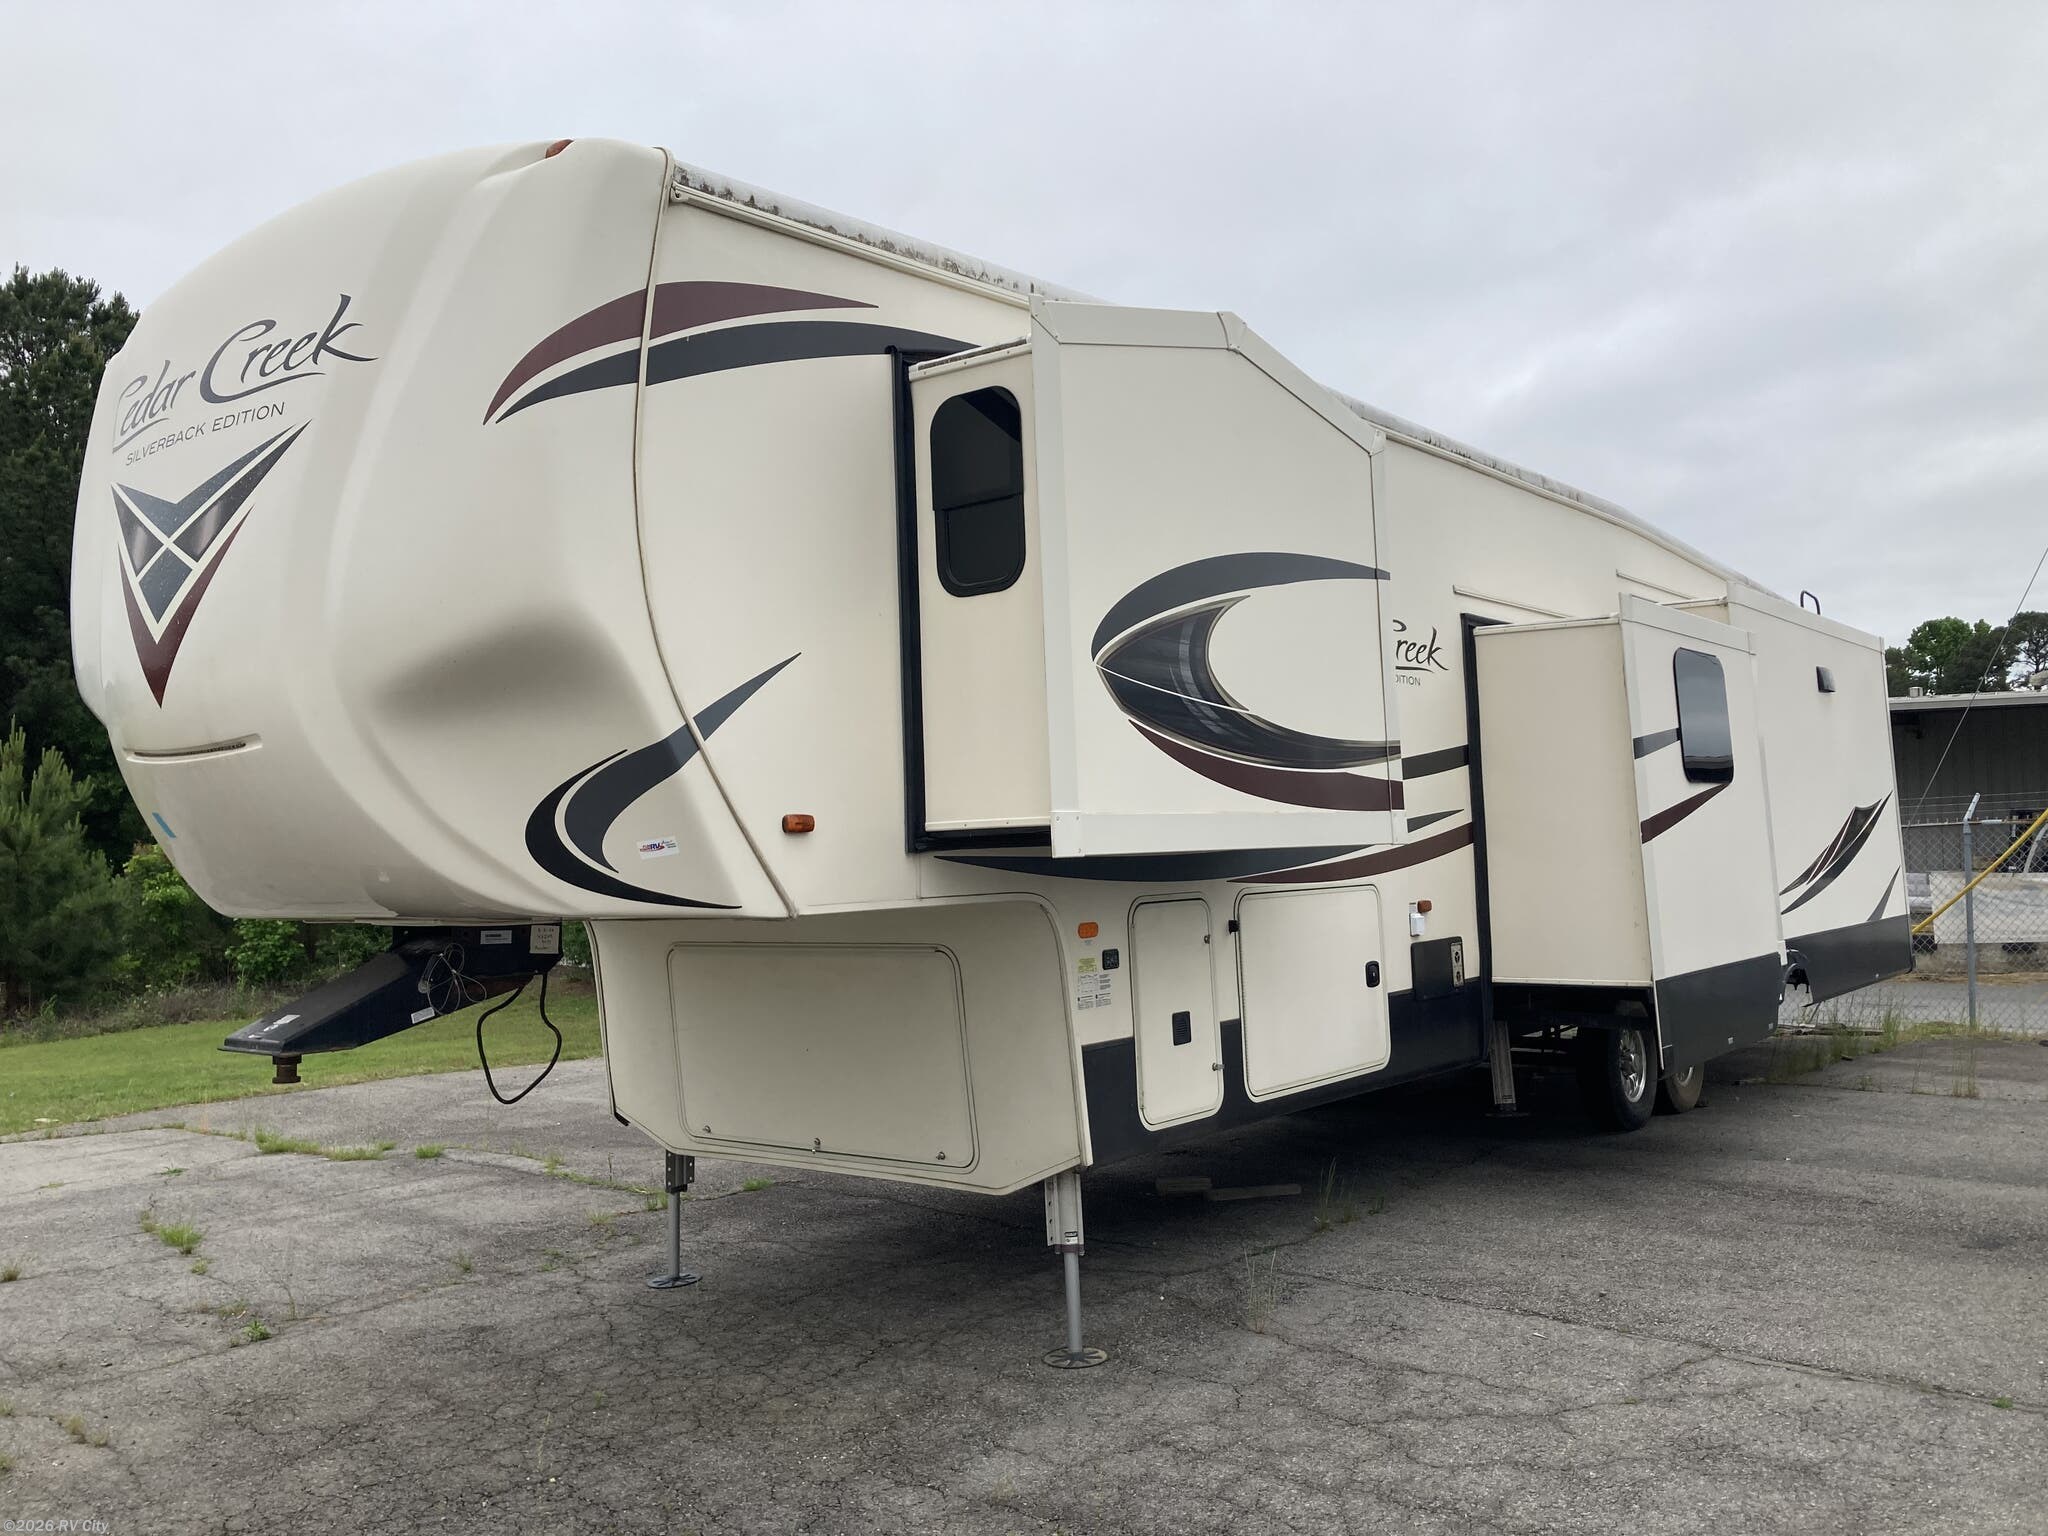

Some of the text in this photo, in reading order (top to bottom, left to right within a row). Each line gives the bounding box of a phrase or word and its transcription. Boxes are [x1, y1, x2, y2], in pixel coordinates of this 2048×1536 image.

[112, 294, 379, 453] Cedar Creek
[126, 402, 285, 466] SILVERBACK EDITION
